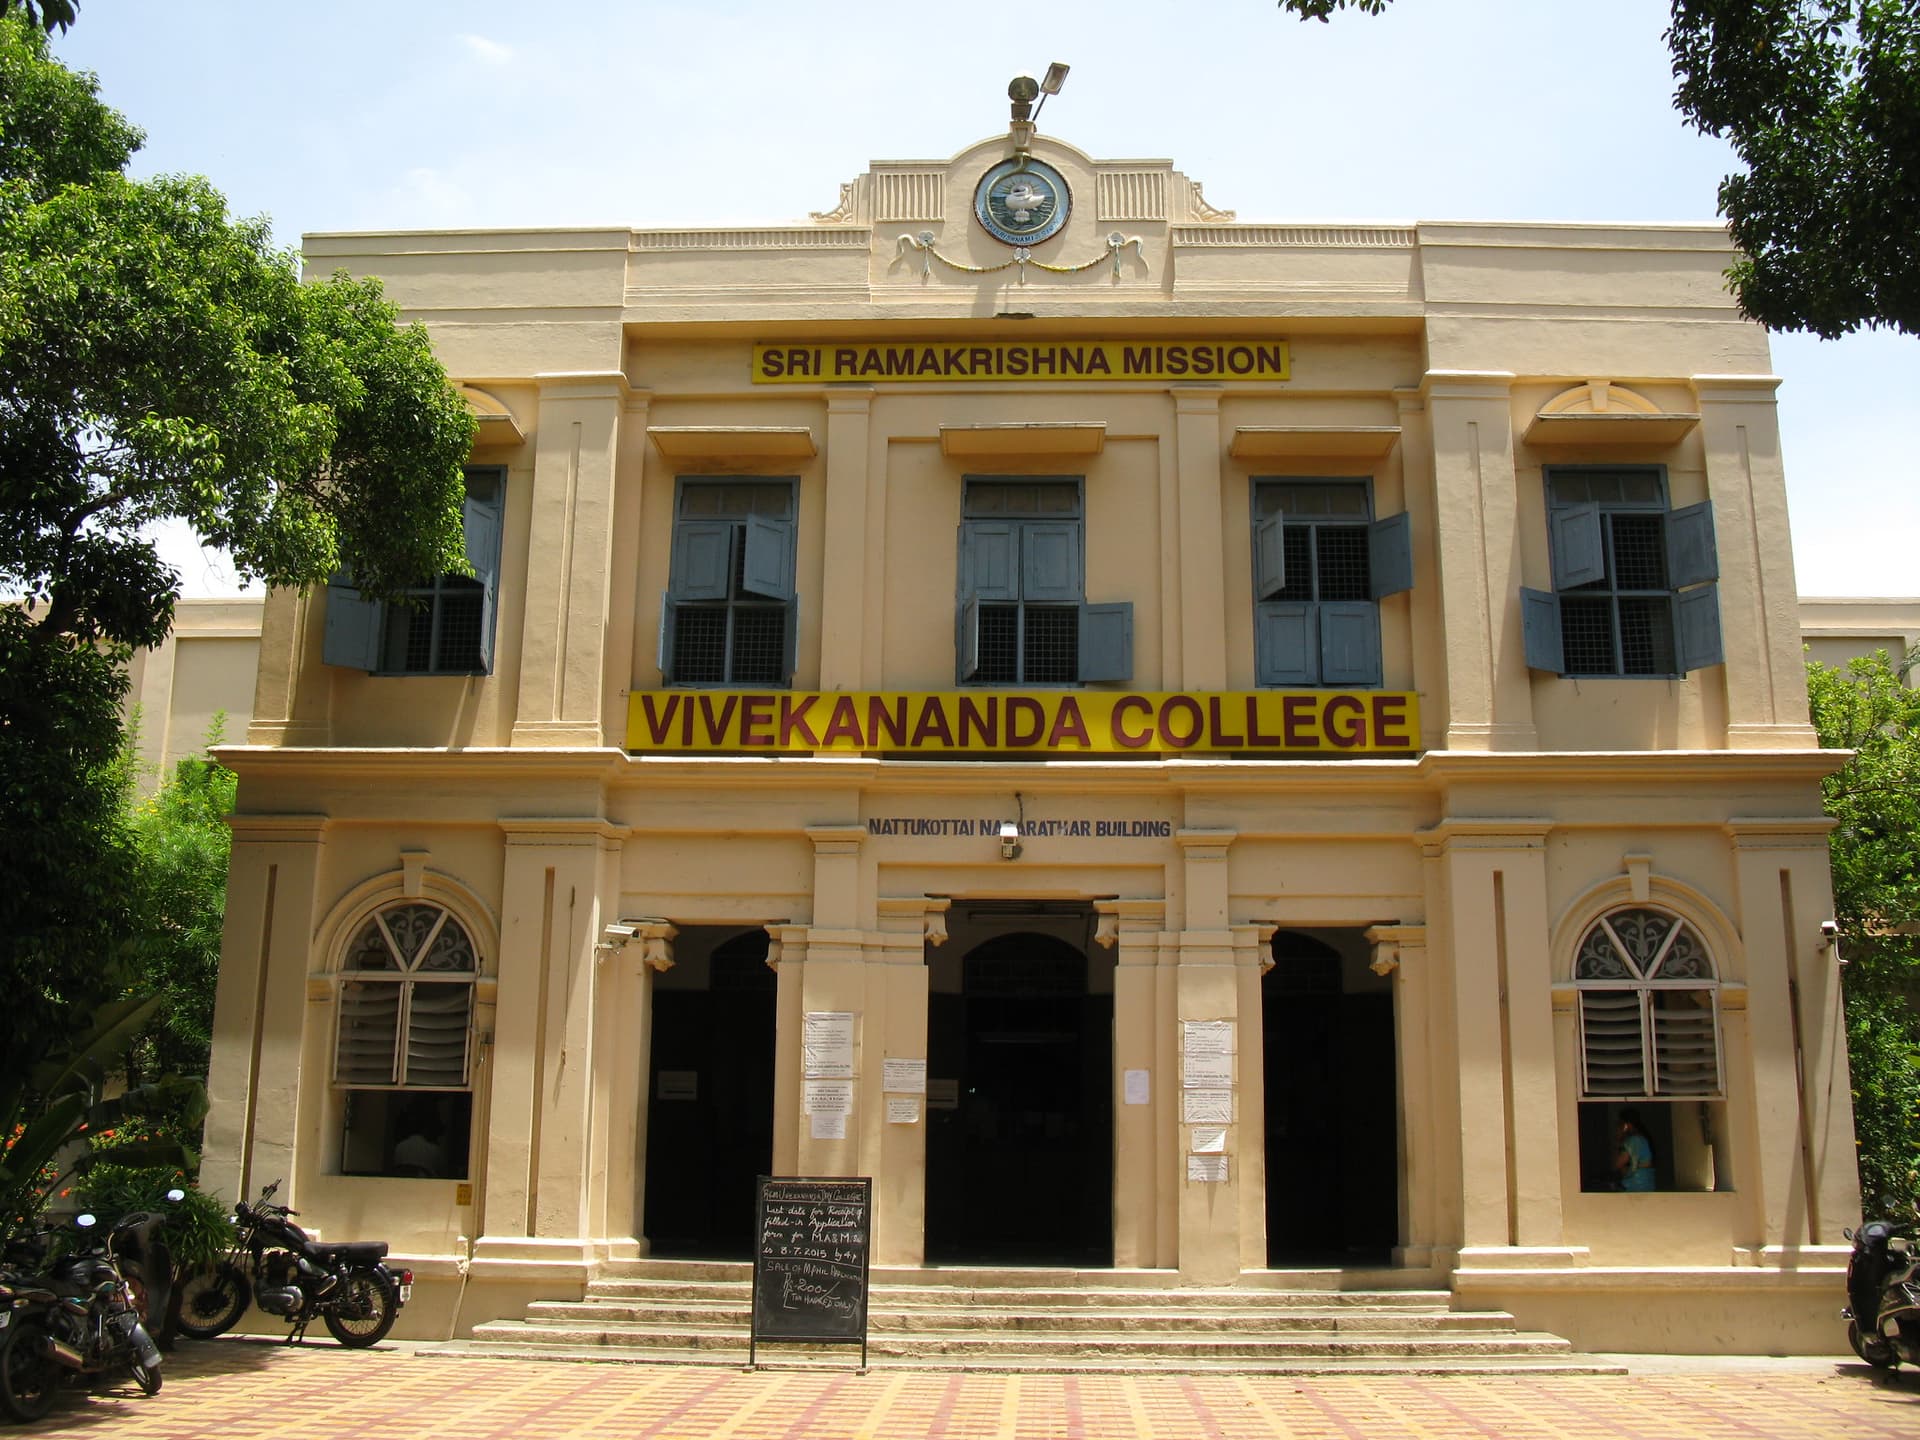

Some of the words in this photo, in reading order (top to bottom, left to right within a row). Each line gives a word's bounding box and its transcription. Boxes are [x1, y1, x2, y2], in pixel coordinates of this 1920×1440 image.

[761, 348, 822, 377] SRI
[834, 347, 1112, 377] RAMAKRISHNA
[1123, 346, 1283, 375] MISSION
[641, 695, 1092, 747] VIVEKANANDA
[1110, 695, 1411, 748] COLLEGE
[868, 818, 975, 836] NATTUKOTTAI
[979, 819, 1090, 837] NAARATHAR
[1096, 820, 1171, 838] BUILDING
[766, 1204, 784, 1215] Last
[788, 1205, 806, 1216] date
[809, 1207, 824, 1219] for
[808, 1216, 858, 1233] Application
[762, 1230, 784, 1244] form
[790, 1231, 804, 1244] for
[762, 1246, 774, 1255] is
[834, 1248, 843, 1262] by
